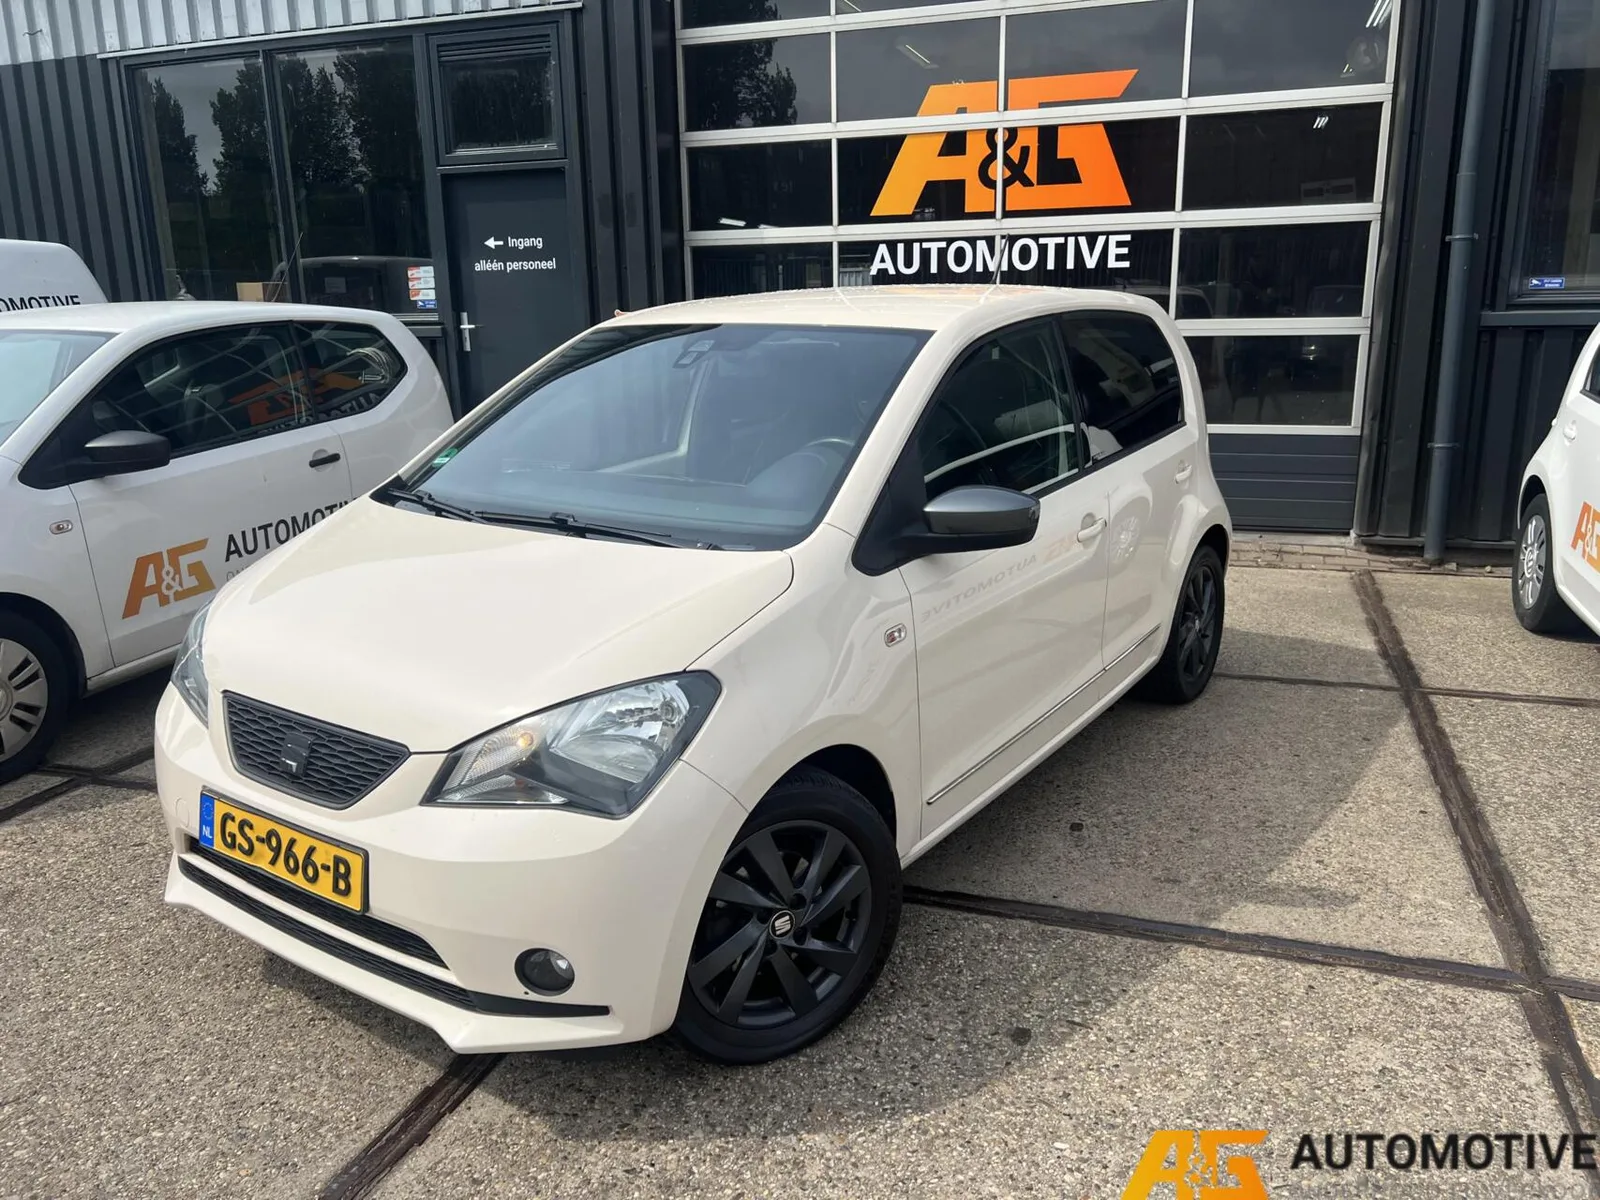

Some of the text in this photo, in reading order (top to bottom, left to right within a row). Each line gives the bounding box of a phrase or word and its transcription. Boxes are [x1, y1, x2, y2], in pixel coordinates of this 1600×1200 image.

[870, 69, 1139, 216] A&G
[508, 236, 543, 250] Ingang
[870, 234, 1132, 275] AUTOMOTIVE
[474, 258, 556, 272] alléén personeel
[122, 538, 217, 619] A&G
[202, 825, 213, 839] NL
[220, 812, 352, 897] GS-966-B
